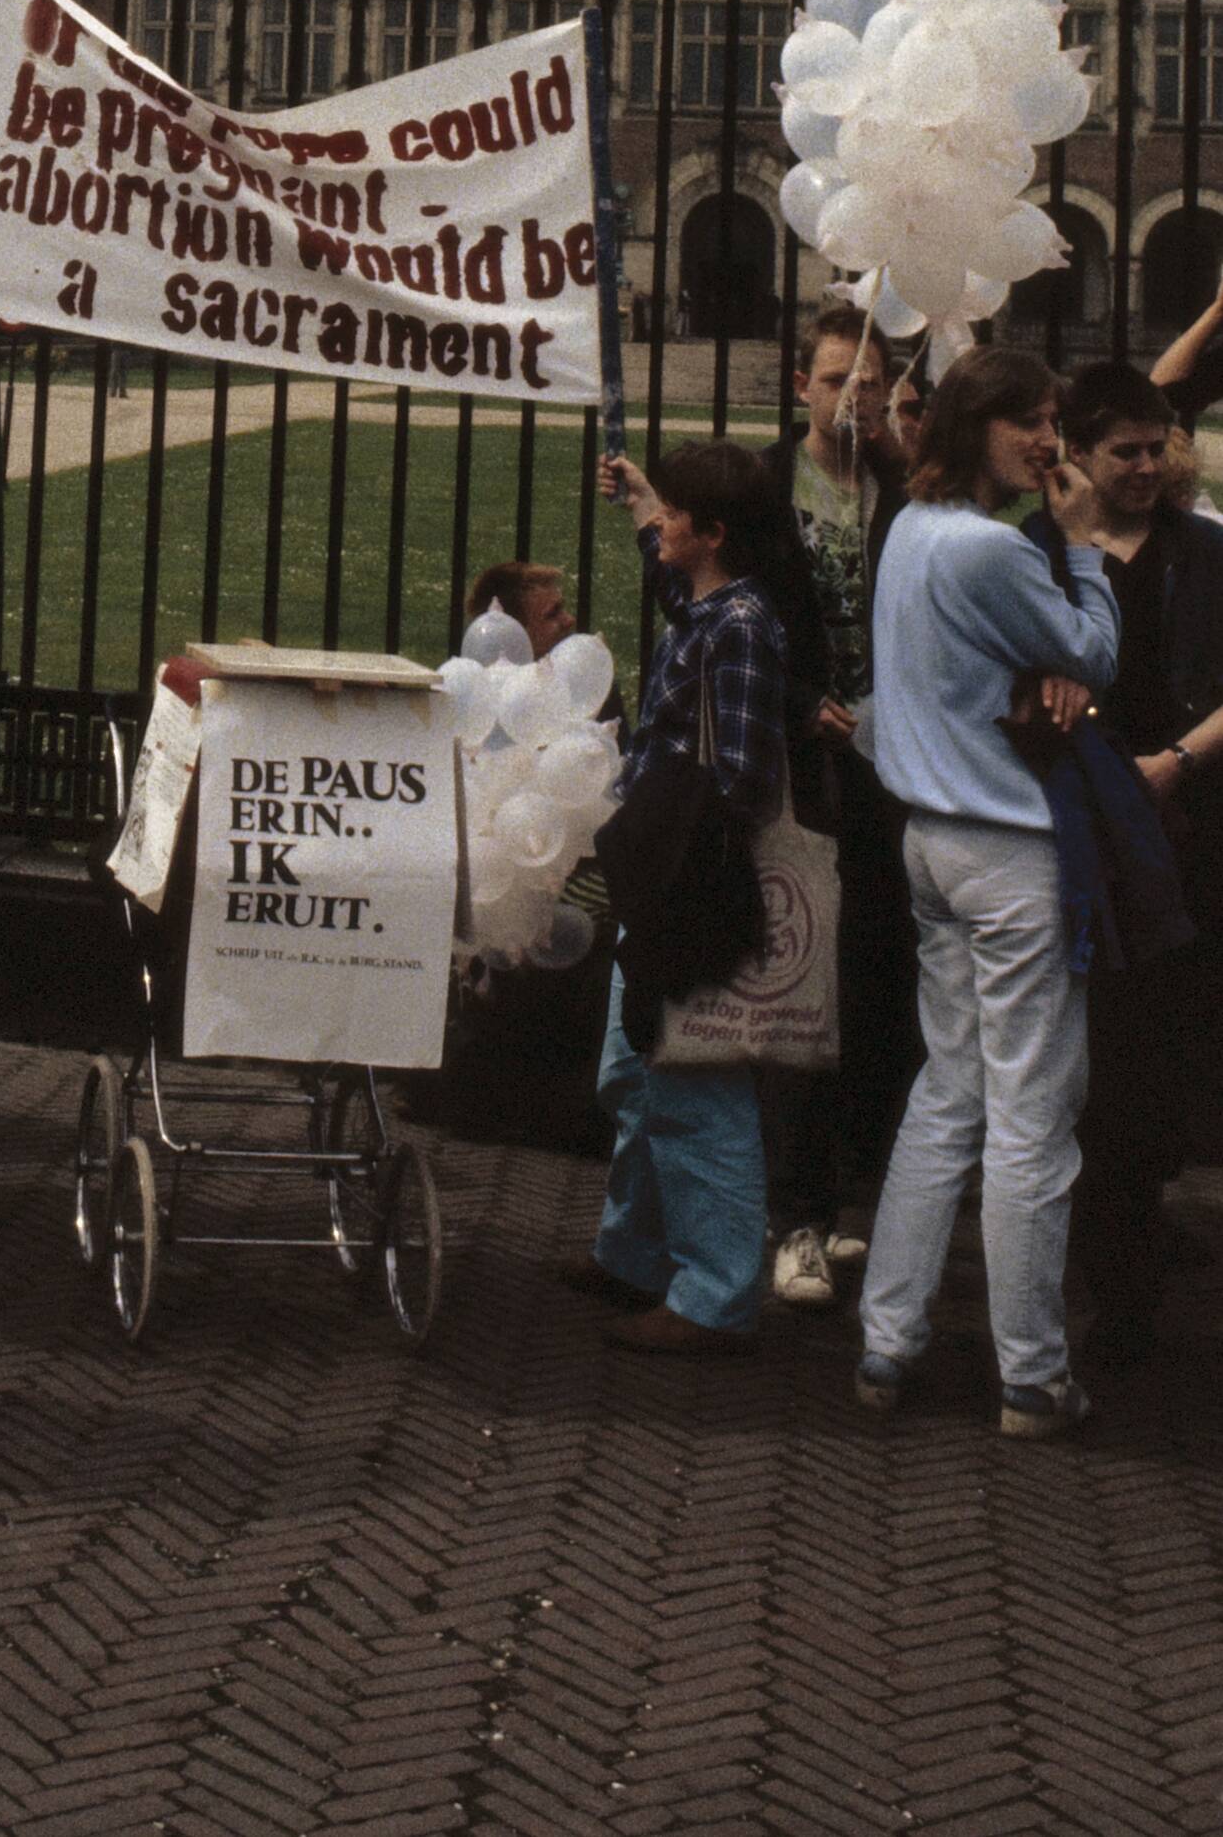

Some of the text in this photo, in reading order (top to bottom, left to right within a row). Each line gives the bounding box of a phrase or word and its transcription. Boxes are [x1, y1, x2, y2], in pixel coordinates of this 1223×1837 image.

[389, 54, 575, 162] could
[6, 61, 86, 148] be
[98, 87, 388, 235] pregnant
[295, 218, 509, 304] would
[522, 218, 596, 301] be
[57, 260, 555, 389] a sacrament
[231, 757, 289, 796] DE
[300, 756, 427, 804] PAUS
[230, 796, 373, 839] ERIN..
[226, 839, 301, 886] IK
[225, 890, 384, 934] ERUIT.
[682, 1020, 742, 1042] tegen
